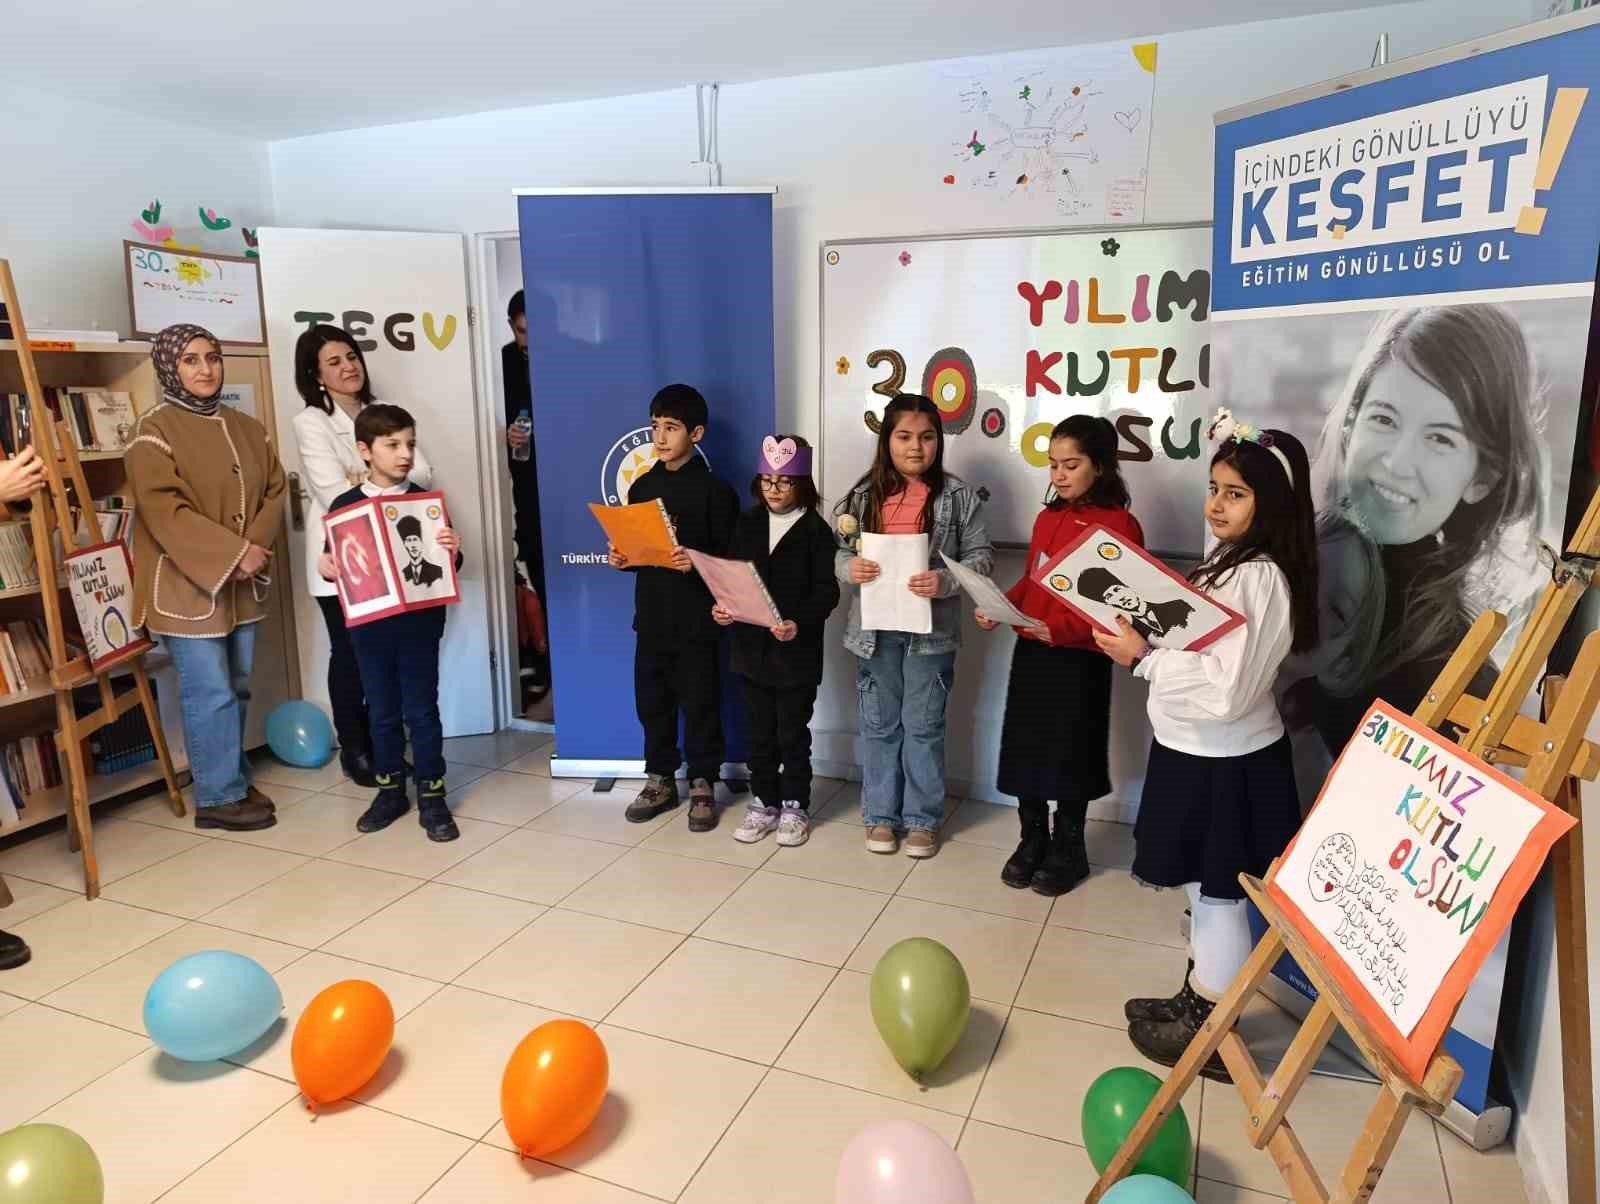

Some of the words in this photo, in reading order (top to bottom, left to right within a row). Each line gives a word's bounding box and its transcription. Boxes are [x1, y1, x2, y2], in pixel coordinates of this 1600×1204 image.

[1243, 137, 1343, 188] İÇİNDEKİ
[1352, 96, 1529, 163] GÖNÜLLÜYÜ
[1241, 262, 1310, 288] EĞİTİM
[1320, 240, 1463, 280] GÖNÜLLÜSÜ
[1478, 240, 1511, 263] OL
[1017, 269, 1211, 327] YILIM
[293, 310, 457, 352] TEGV
[561, 552, 609, 564] TÜRKİYE
[1395, 784, 1496, 882] KUTLU
[1389, 838, 1489, 935] OLSUN
